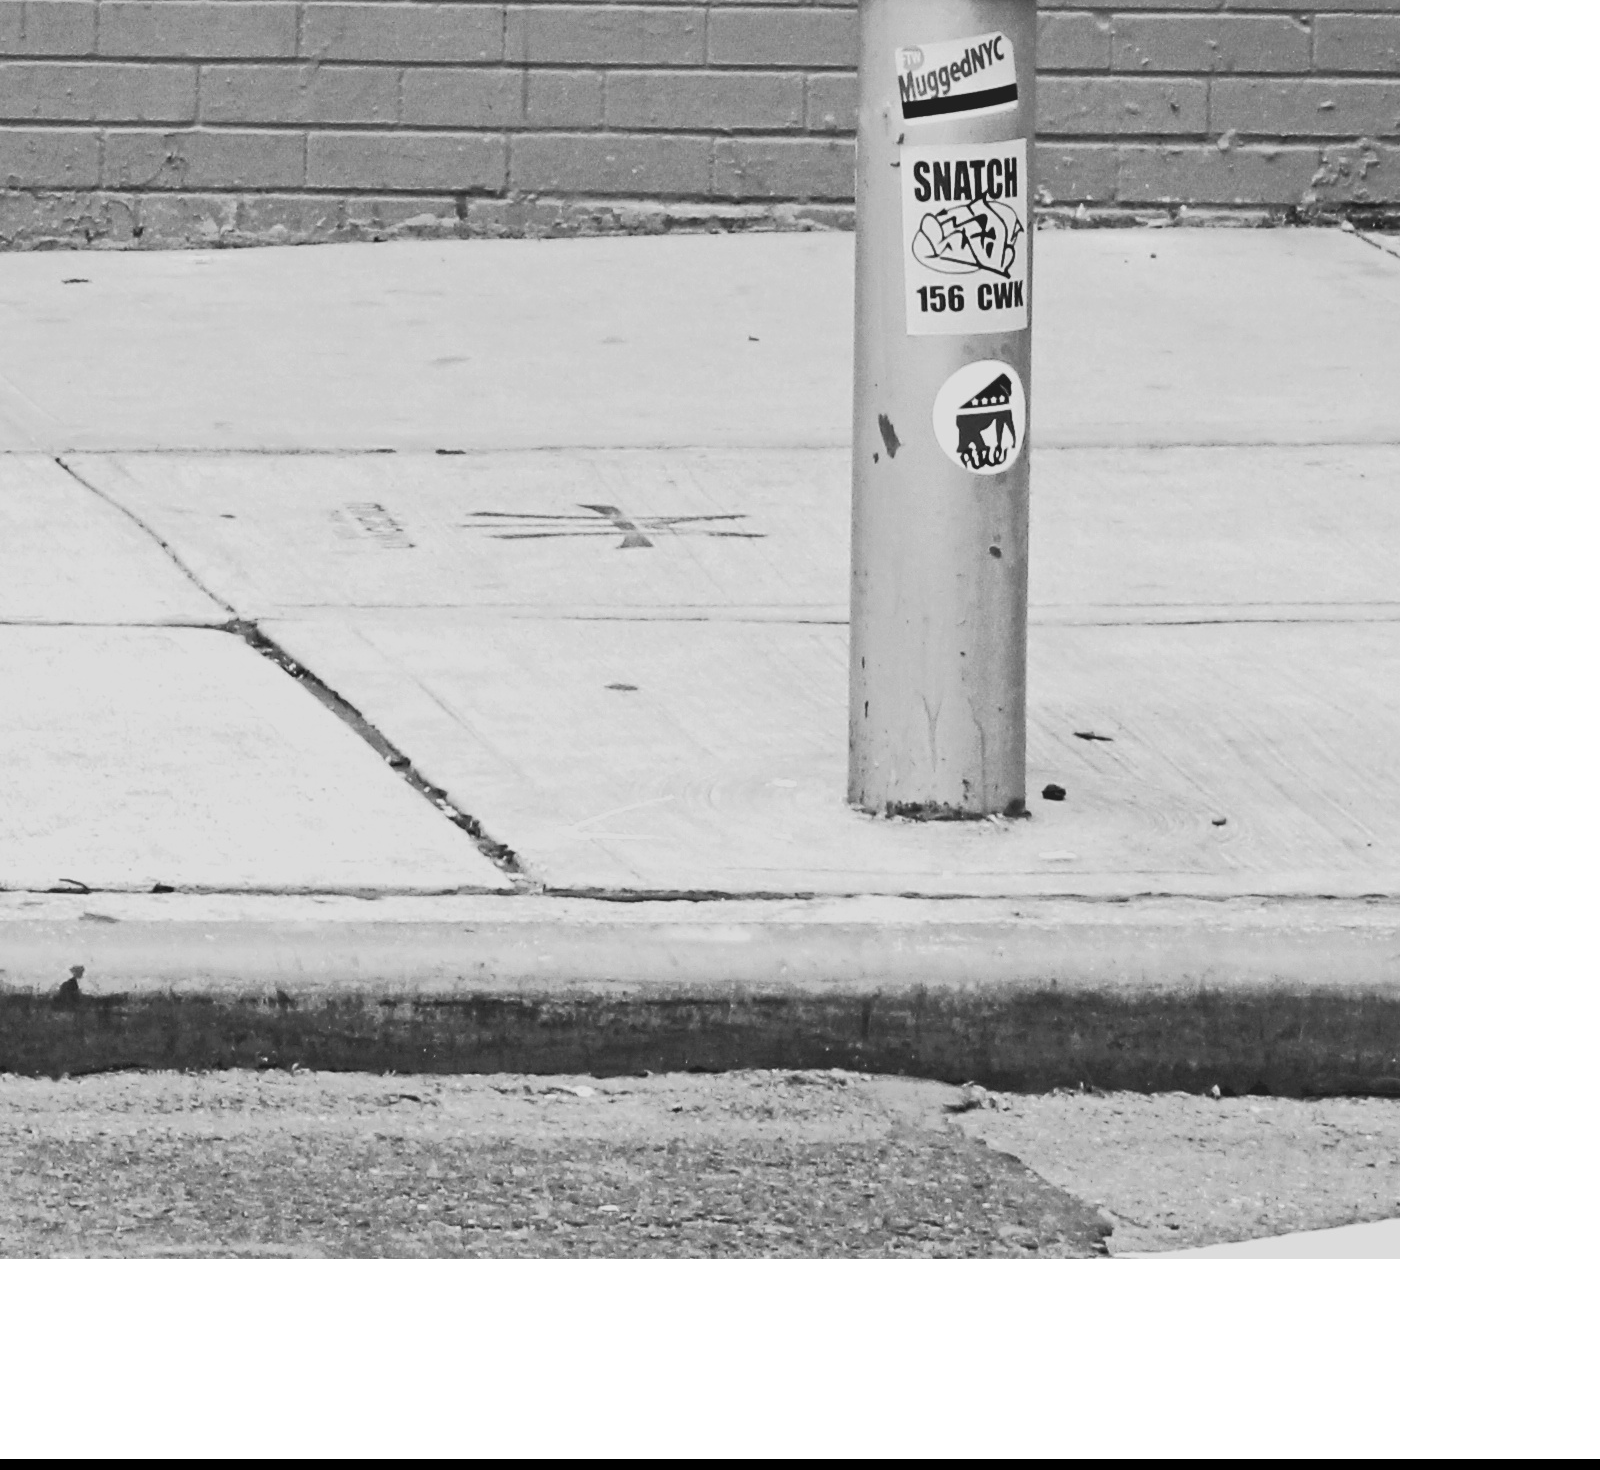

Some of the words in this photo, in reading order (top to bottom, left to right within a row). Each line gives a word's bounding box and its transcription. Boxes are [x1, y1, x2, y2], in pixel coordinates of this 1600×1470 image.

[898, 35, 1004, 102] MuggedNYC
[913, 157, 1018, 203] SNATCH
[916, 284, 965, 313] 156
[977, 280, 1024, 311] CWK
